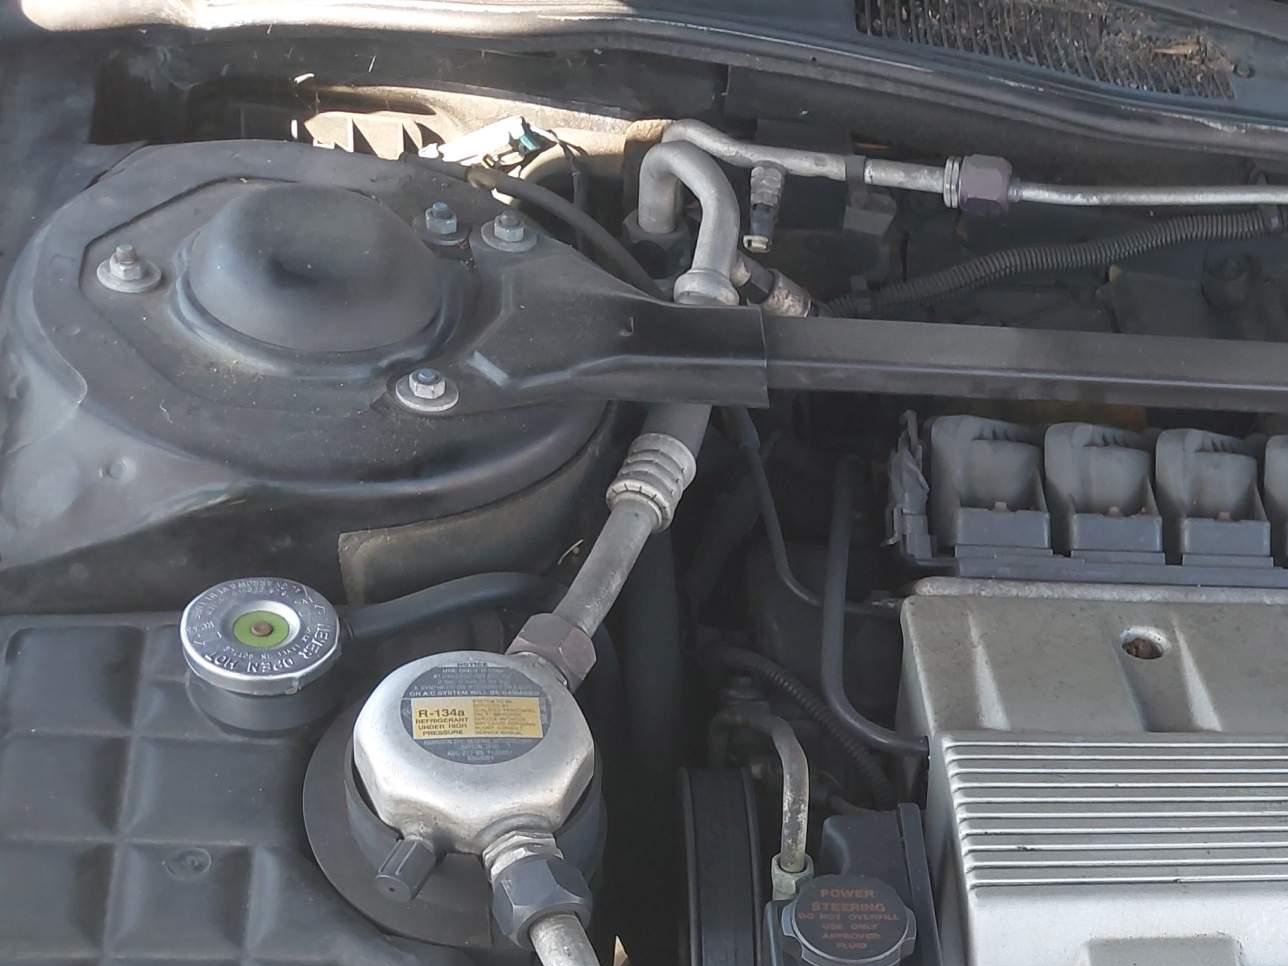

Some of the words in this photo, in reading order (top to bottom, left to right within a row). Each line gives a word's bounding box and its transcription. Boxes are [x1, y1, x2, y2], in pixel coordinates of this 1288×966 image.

[418, 708, 465, 718] R-134a
[415, 717, 469, 725] REFRIGERANT
[422, 729, 464, 737] PRESSURE
[820, 889, 875, 898] POWER
[811, 902, 886, 912] STEERING
